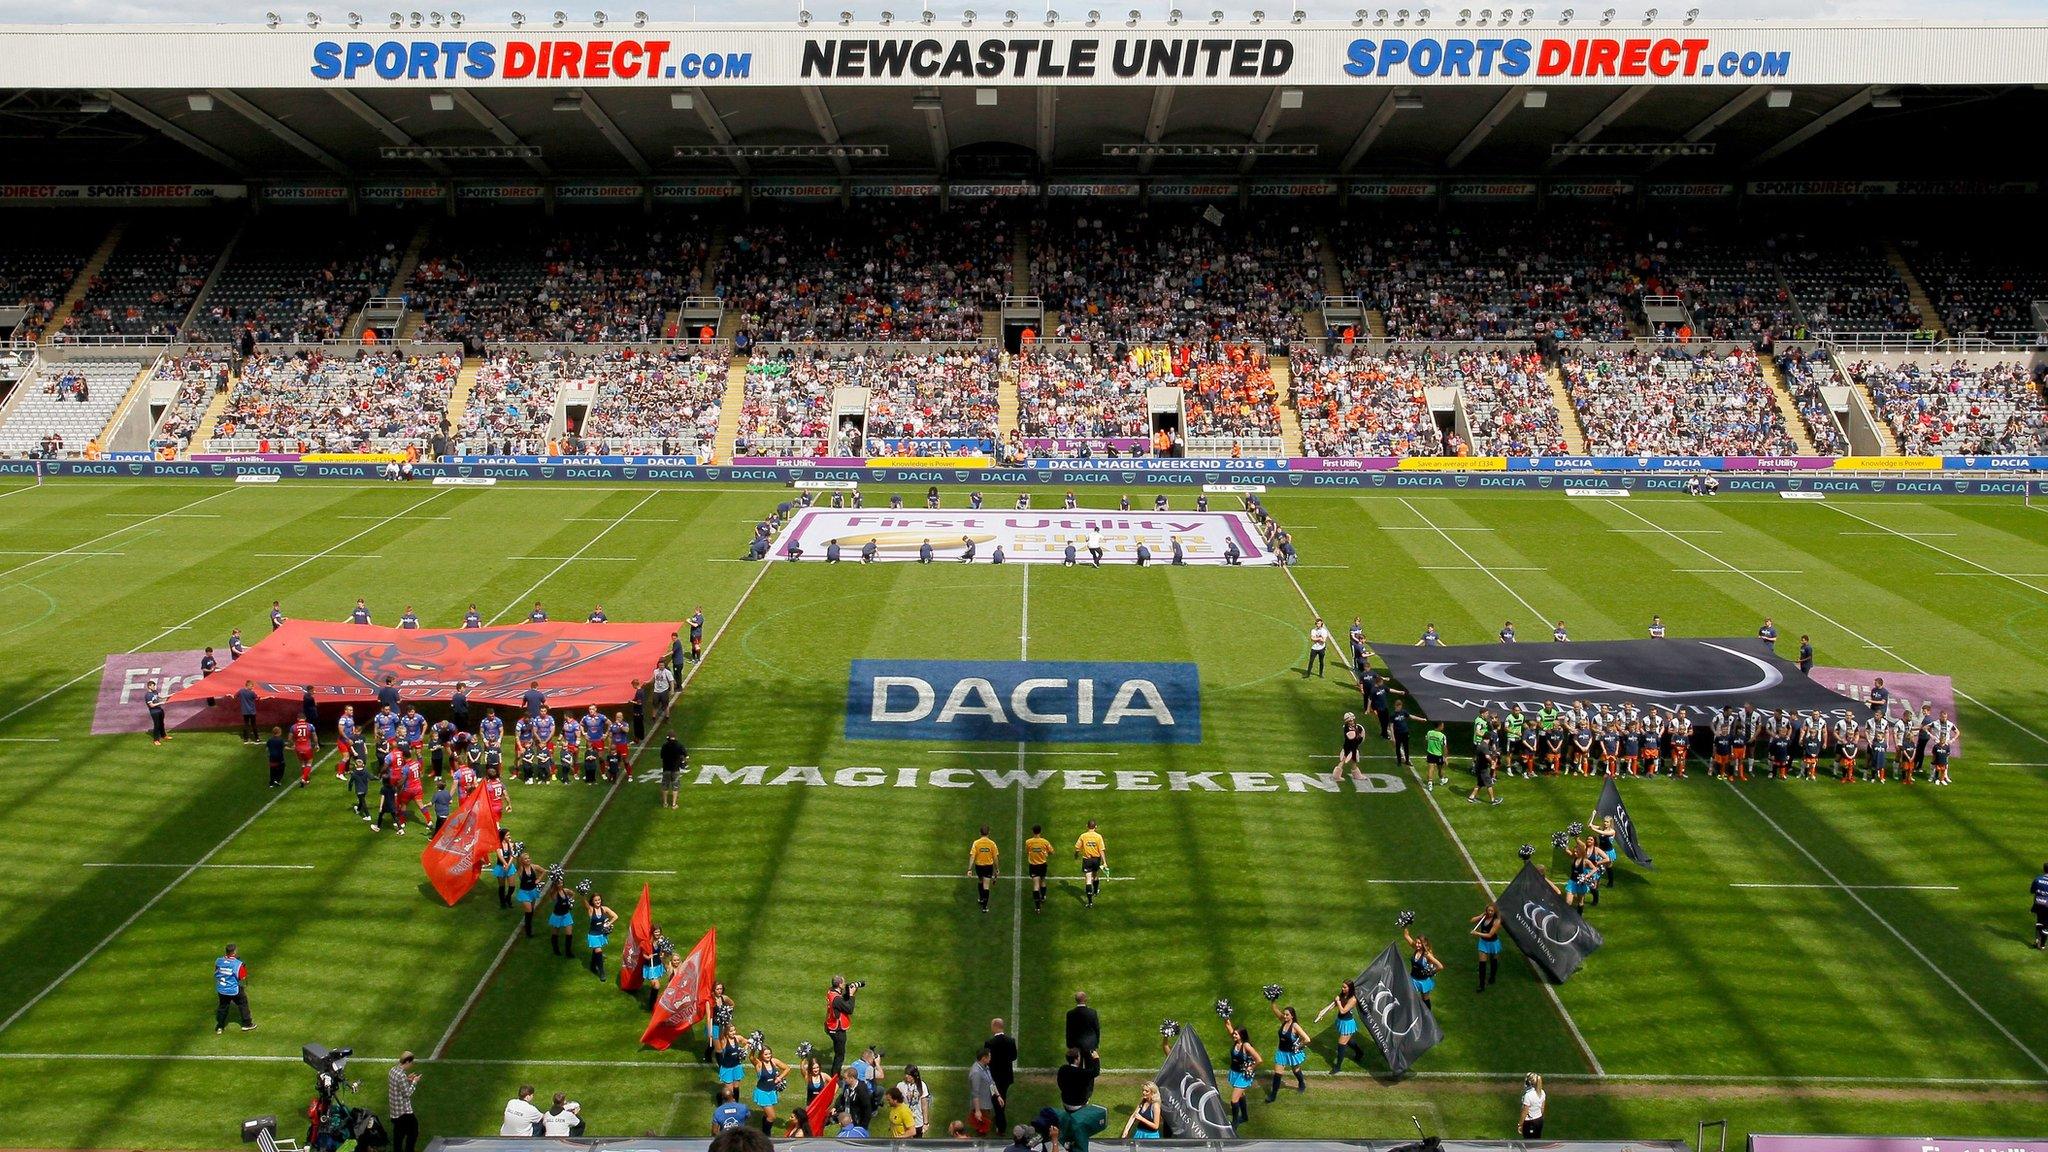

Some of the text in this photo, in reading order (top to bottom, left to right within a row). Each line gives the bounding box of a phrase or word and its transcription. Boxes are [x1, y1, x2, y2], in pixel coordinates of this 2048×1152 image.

[800, 38, 1294, 79] NEWCASTLE UNITED
[478, 456, 518, 464] DACIA
[563, 456, 602, 465] DACIA
[647, 457, 687, 466] DACIA
[776, 459, 792, 467] First
[1049, 459, 1265, 469] DACIA MAGIC WEEKEND 2016
[1322, 459, 1363, 469] First Utility
[1417, 460, 1432, 468] Save
[1443, 461, 1468, 469] average
[1555, 458, 1592, 467] DACIA
[1663, 458, 1702, 467] DACIA
[1758, 459, 1798, 469] First Utility
[1861, 459, 1898, 468] Knowledge
[1905, 460, 1925, 468] Power
[1991, 458, 2030, 467] DACIA
[74, 465, 118, 474] DACIA
[155, 465, 200, 474] DACIA
[236, 466, 282, 475] DACIA
[319, 467, 364, 476] DACIA
[411, 467, 447, 477] ACIA
[484, 468, 530, 477] DACIA
[567, 468, 613, 478] DACIA
[648, 469, 695, 479] DACIA
[731, 470, 777, 479] DACIA
[815, 471, 860, 480] DACIA
[898, 471, 943, 481] DACIA
[981, 472, 1027, 481] DACIA
[1063, 473, 1110, 482] DACIA
[1147, 474, 1193, 483] DACIA
[1230, 475, 1276, 484] DACIA
[1314, 476, 1360, 485] DACIA
[1397, 476, 1443, 486] DACIA
[1480, 477, 1525, 487] DACIA
[1563, 478, 1609, 488] DACIA
[1730, 480, 1776, 490] DACIA
[1813, 481, 1859, 490] DACIA
[1896, 482, 1942, 491] DACIA
[1979, 483, 2026, 492] DACIA
[846, 517, 1205, 533] First Utility
[871, 676, 1176, 725] DACIA
[297, 728, 307, 738] 21
[464, 774, 473, 783] 15
[494, 788, 503, 798] 19
